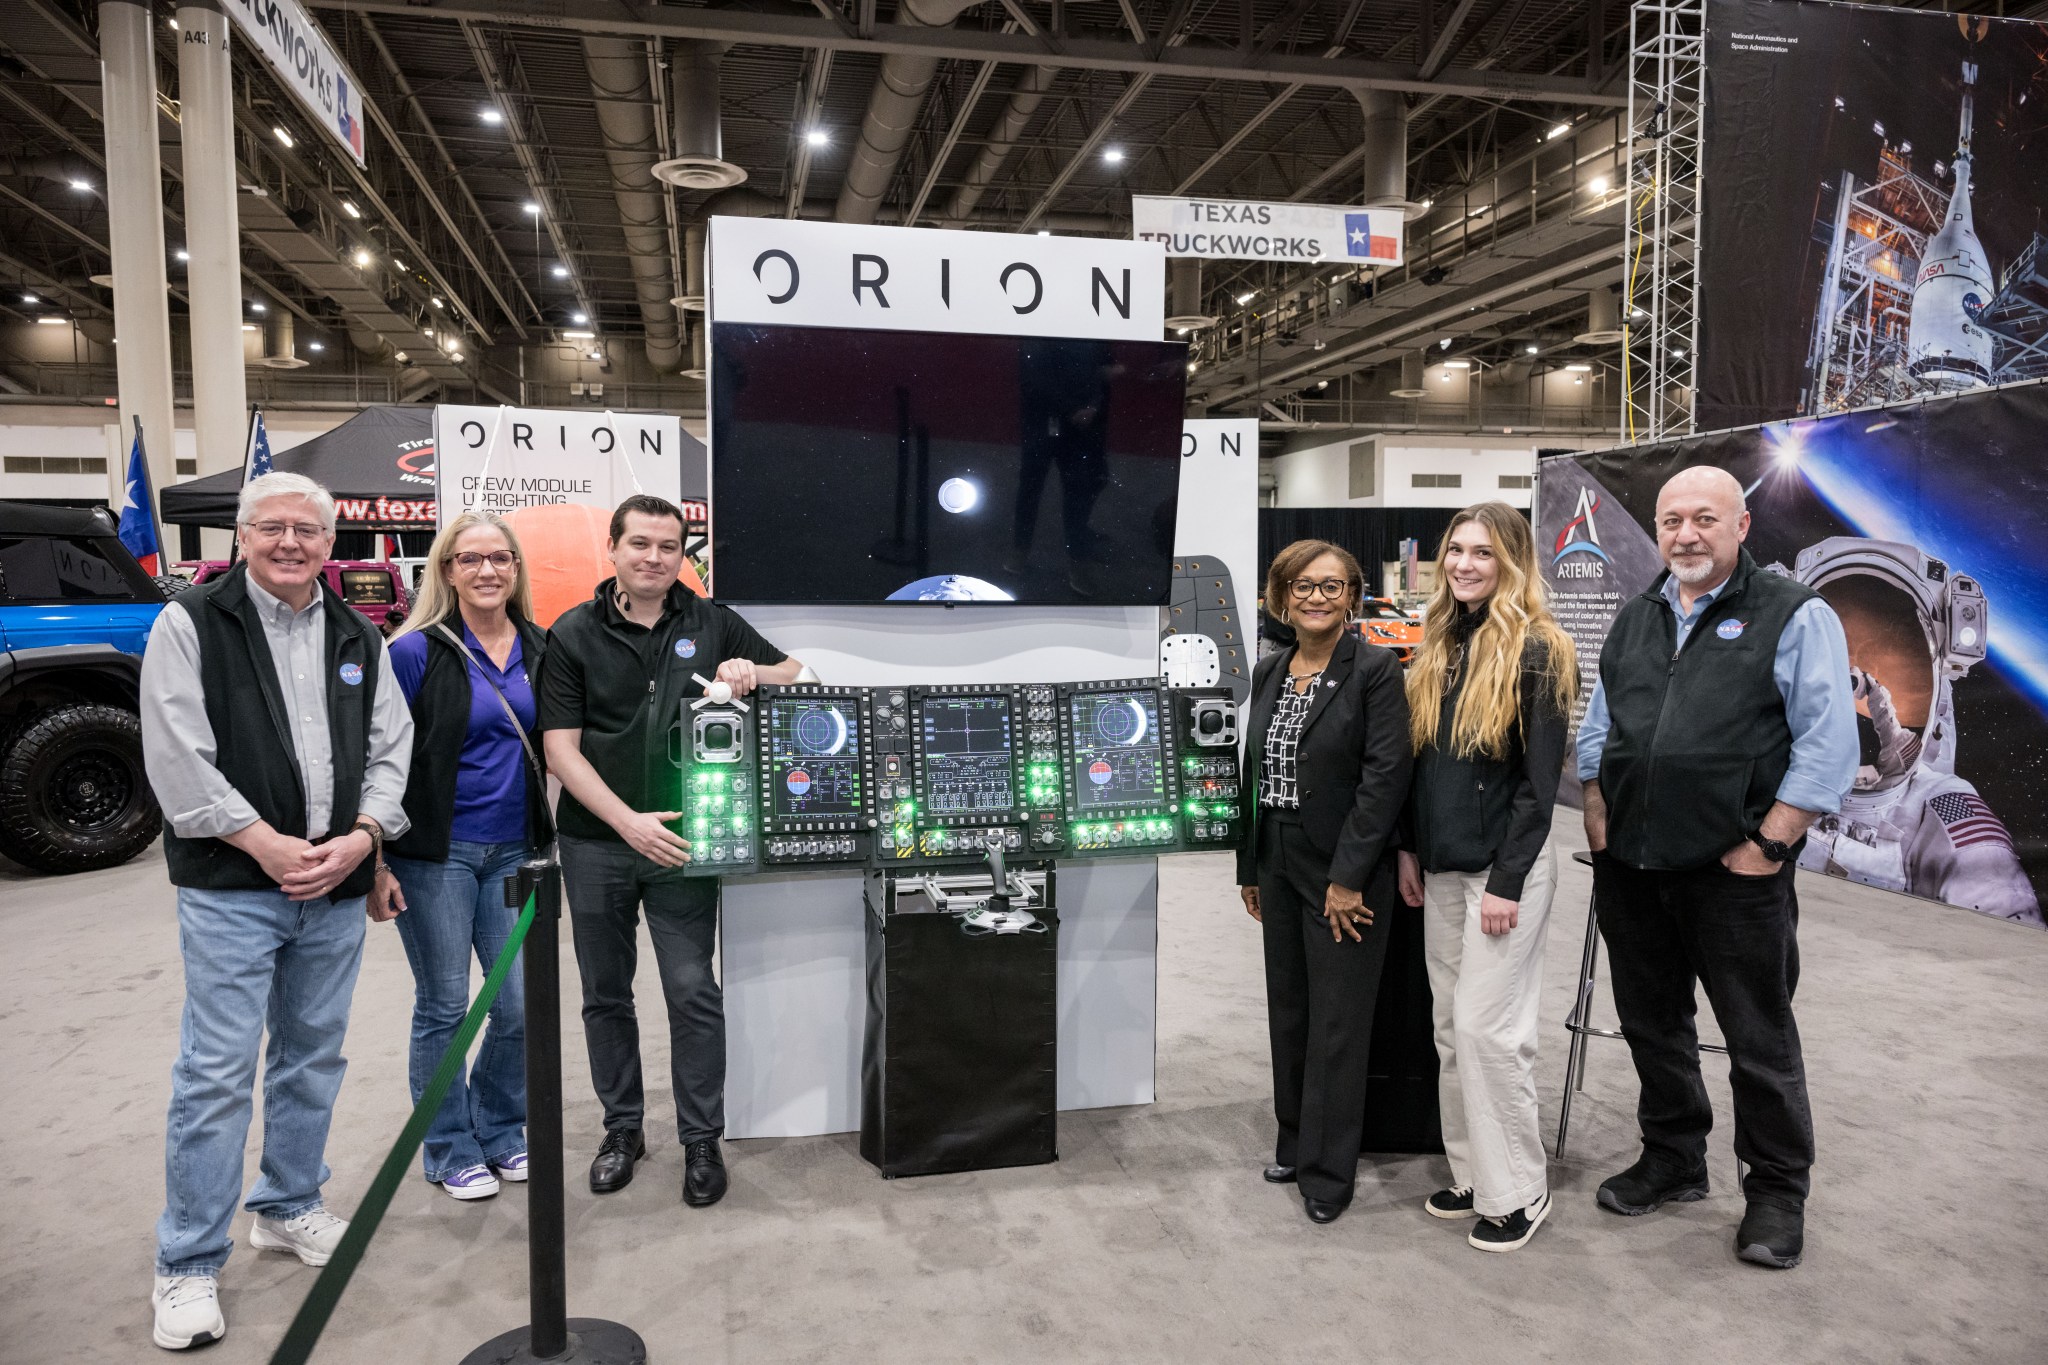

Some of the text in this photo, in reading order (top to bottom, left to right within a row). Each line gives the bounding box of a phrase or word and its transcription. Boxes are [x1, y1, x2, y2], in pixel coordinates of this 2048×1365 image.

[1731, 32, 1754, 40] National
[1755, 34, 1787, 43] Aeronautics
[1731, 42, 1788, 53] Space Administration
[240, 0, 332, 114] ckworks
[1190, 203, 1271, 225] TEXAS
[753, 249, 1130, 319] ORION
[1971, 329, 1983, 339] esa
[460, 420, 662, 456] ORION
[1182, 432, 1241, 458] ON
[521, 478, 592, 494] MODULE
[1557, 562, 1604, 578] ARTEMIS
[1559, 592, 1578, 600] Artemis
[1579, 592, 1602, 601] missions,
[1604, 591, 1620, 600] NASA
[1606, 602, 1617, 610] and
[1575, 611, 1580, 619] of
[1581, 611, 1594, 619] color
[1602, 612, 1612, 620] the
[1563, 622, 1576, 630] using
[1719, 625, 1741, 633] NASA
[1585, 632, 1602, 640] explore
[676, 644, 695, 652] NASA
[1576, 641, 1593, 649] surface
[341, 669, 362, 678] NASA
